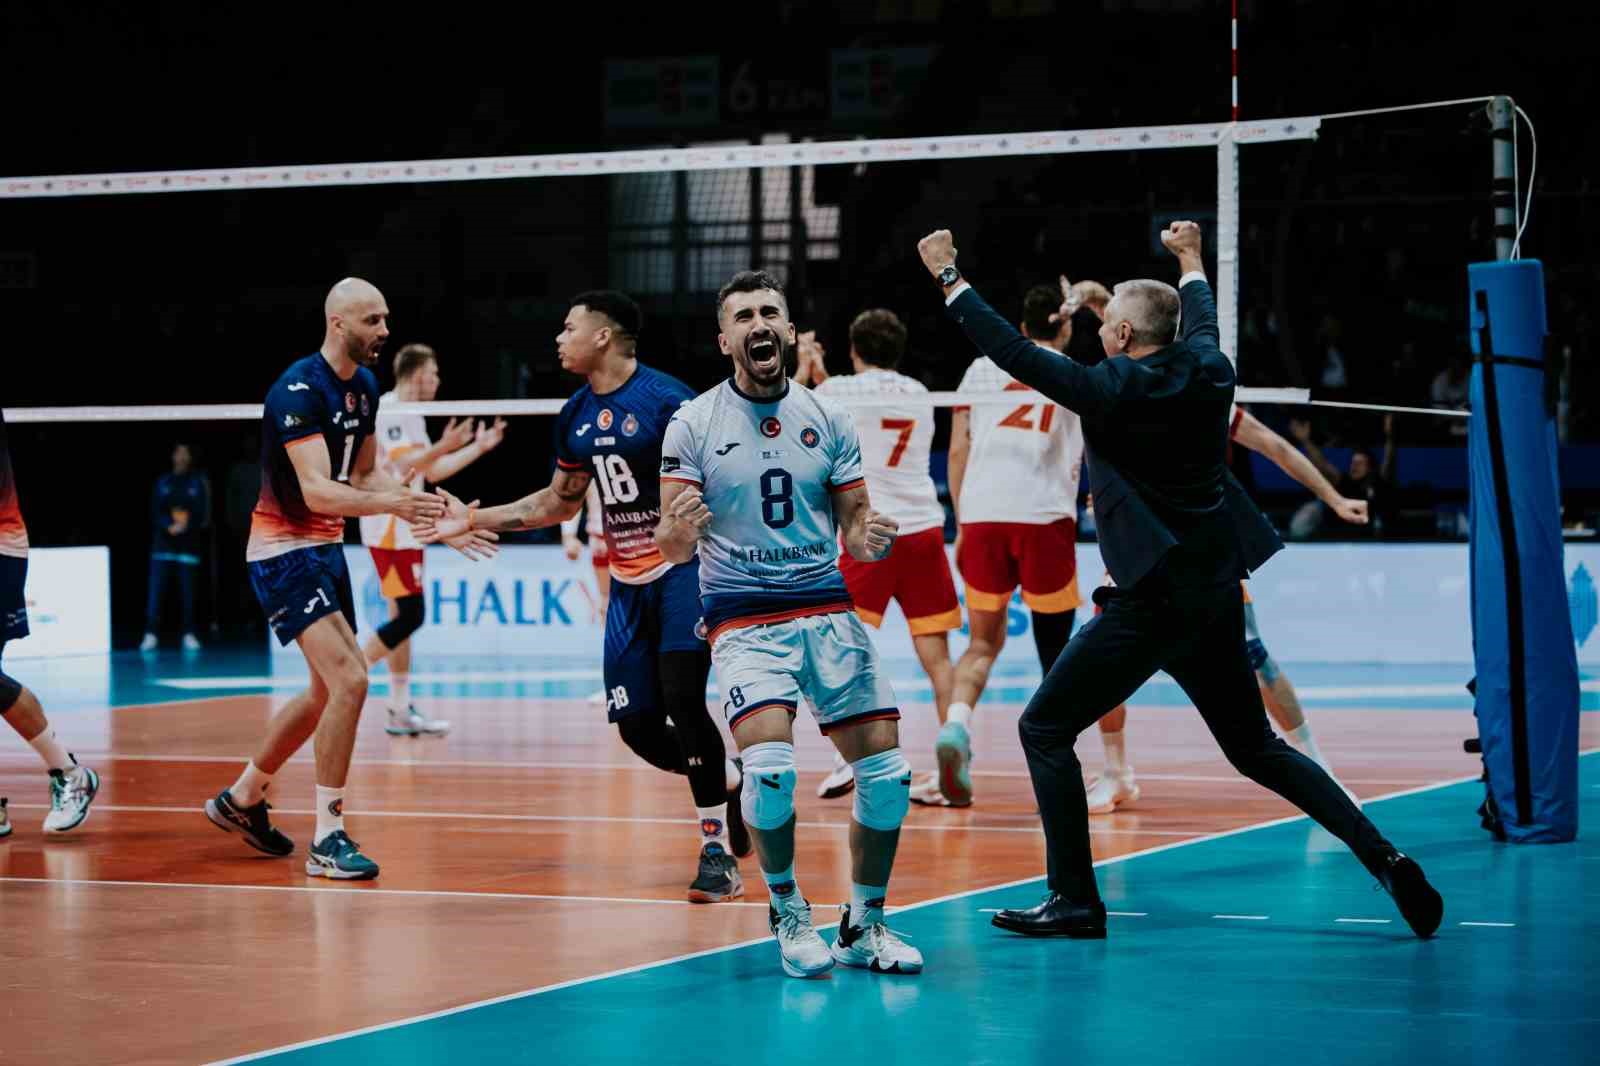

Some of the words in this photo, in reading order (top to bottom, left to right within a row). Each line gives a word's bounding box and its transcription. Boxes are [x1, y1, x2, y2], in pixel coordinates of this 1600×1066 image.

[338, 434, 355, 481] 1
[881, 419, 916, 467] 7
[592, 454, 639, 505] 18
[760, 468, 794, 530] 8
[749, 541, 827, 563] HALKBANK
[316, 588, 331, 607] 1
[432, 578, 573, 625] HALK
[611, 685, 629, 710] 18
[729, 685, 745, 708] 8
